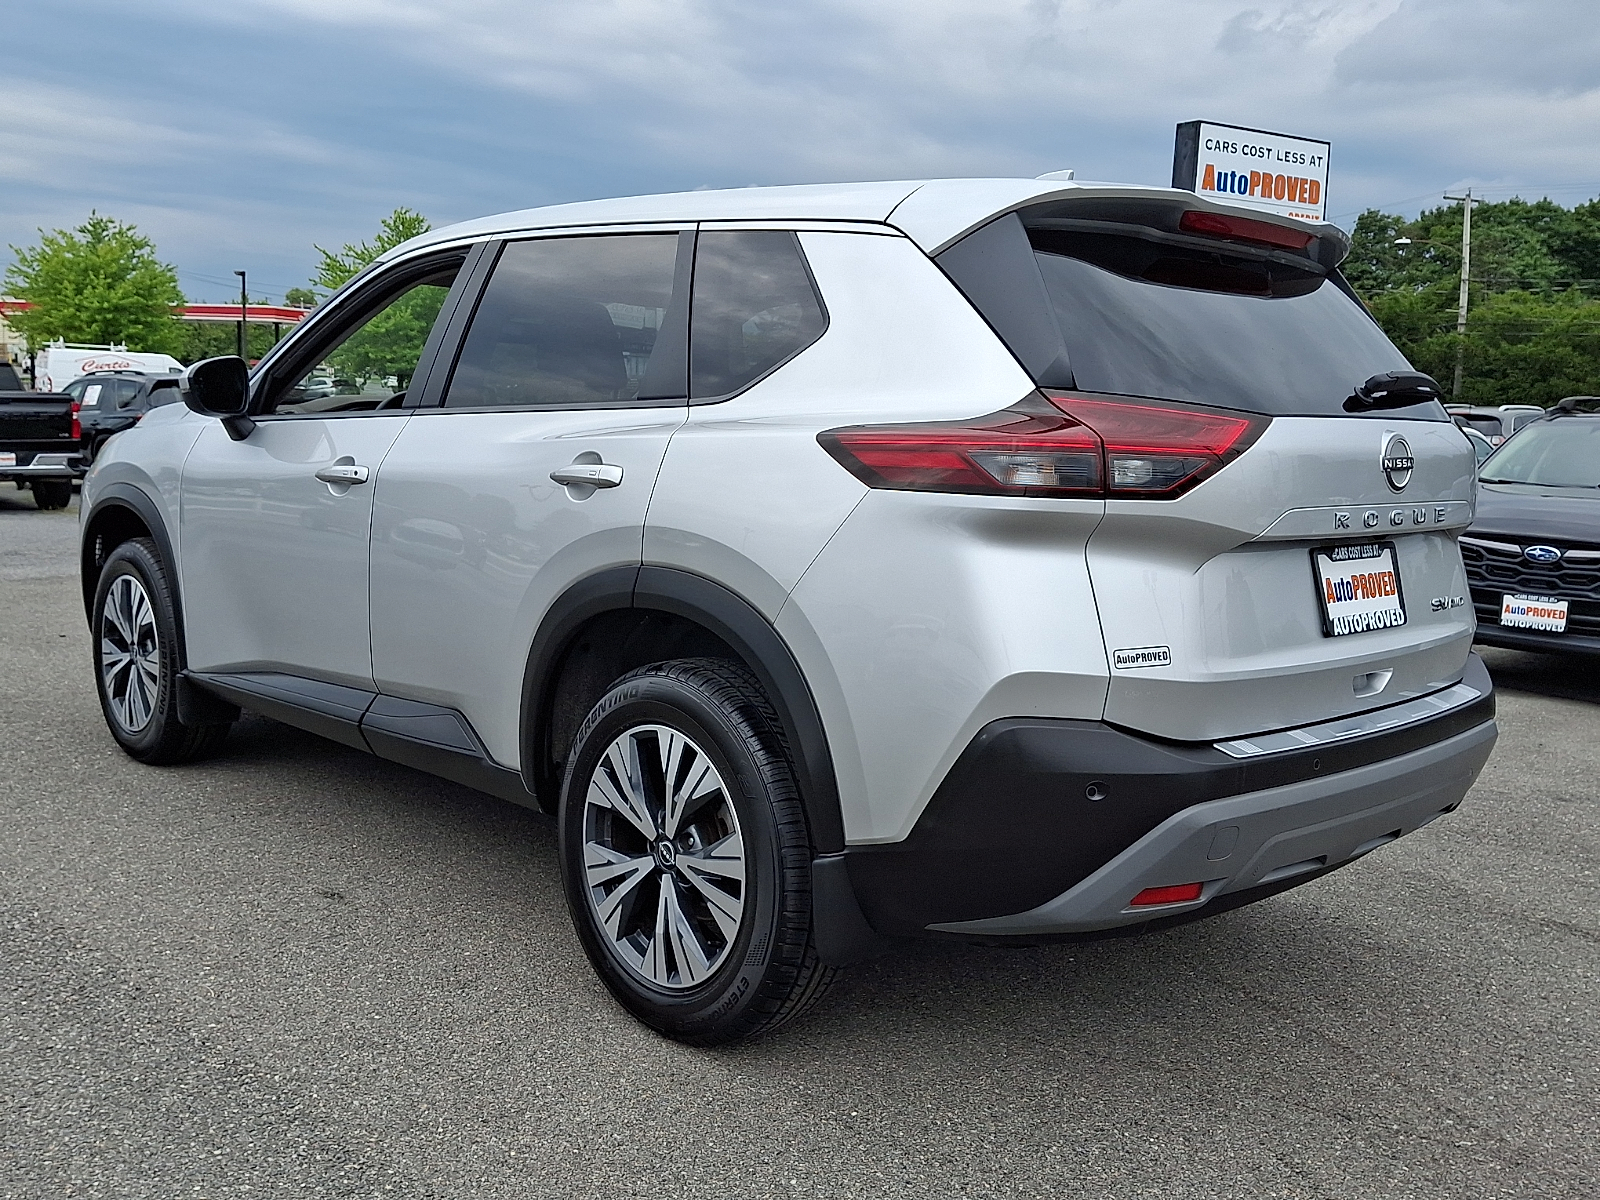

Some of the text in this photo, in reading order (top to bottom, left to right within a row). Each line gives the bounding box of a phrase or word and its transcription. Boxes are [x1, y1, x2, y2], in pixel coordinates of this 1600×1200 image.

[1205, 139, 1324, 168] CARS COST LESS AT
[1201, 164, 1321, 205] AutoPROVED
[81, 359, 130, 372] Curtis
[1334, 507, 1446, 529] ROGUE
[1335, 547, 1349, 560] CARS
[1349, 546, 1361, 559] COST
[1361, 545, 1373, 558] LESS
[1325, 571, 1396, 603] AutoPROVED
[1504, 604, 1566, 620] AutoPROVED
[1333, 608, 1405, 636] AUTOPROVED
[1501, 618, 1565, 632] AUTOPROVED
[1117, 651, 1168, 665] AutoPROVED
